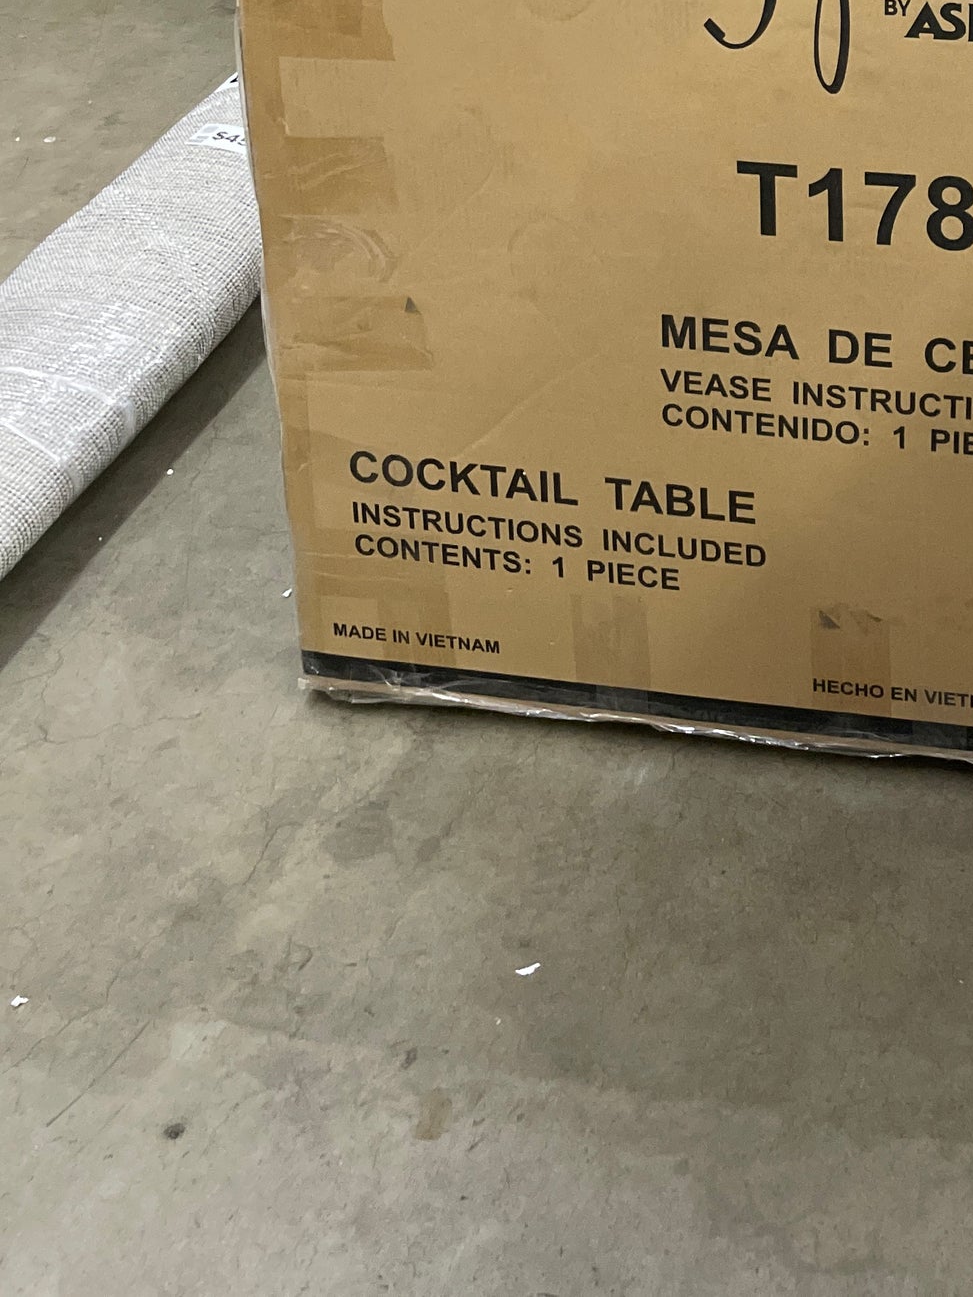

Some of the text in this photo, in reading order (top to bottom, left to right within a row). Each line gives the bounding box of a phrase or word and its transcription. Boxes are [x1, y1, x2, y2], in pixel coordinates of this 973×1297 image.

[884, 0, 910, 16] BY
[662, 314, 798, 360] MESA
[828, 330, 893, 368] DE
[660, 369, 771, 402] VEASE
[662, 403, 870, 446] CONTENIDO:
[892, 426, 906, 449] 1
[350, 450, 756, 524] COCKTAIL TABLE
[352, 502, 766, 568] INSTRUCTIONS INCLUDED
[355, 534, 680, 591] CONTENTS: 1 PIECE
[333, 623, 500, 654] MADE IN VIETNAM
[812, 678, 884, 698] HECHO
[890, 686, 918, 702] EN
